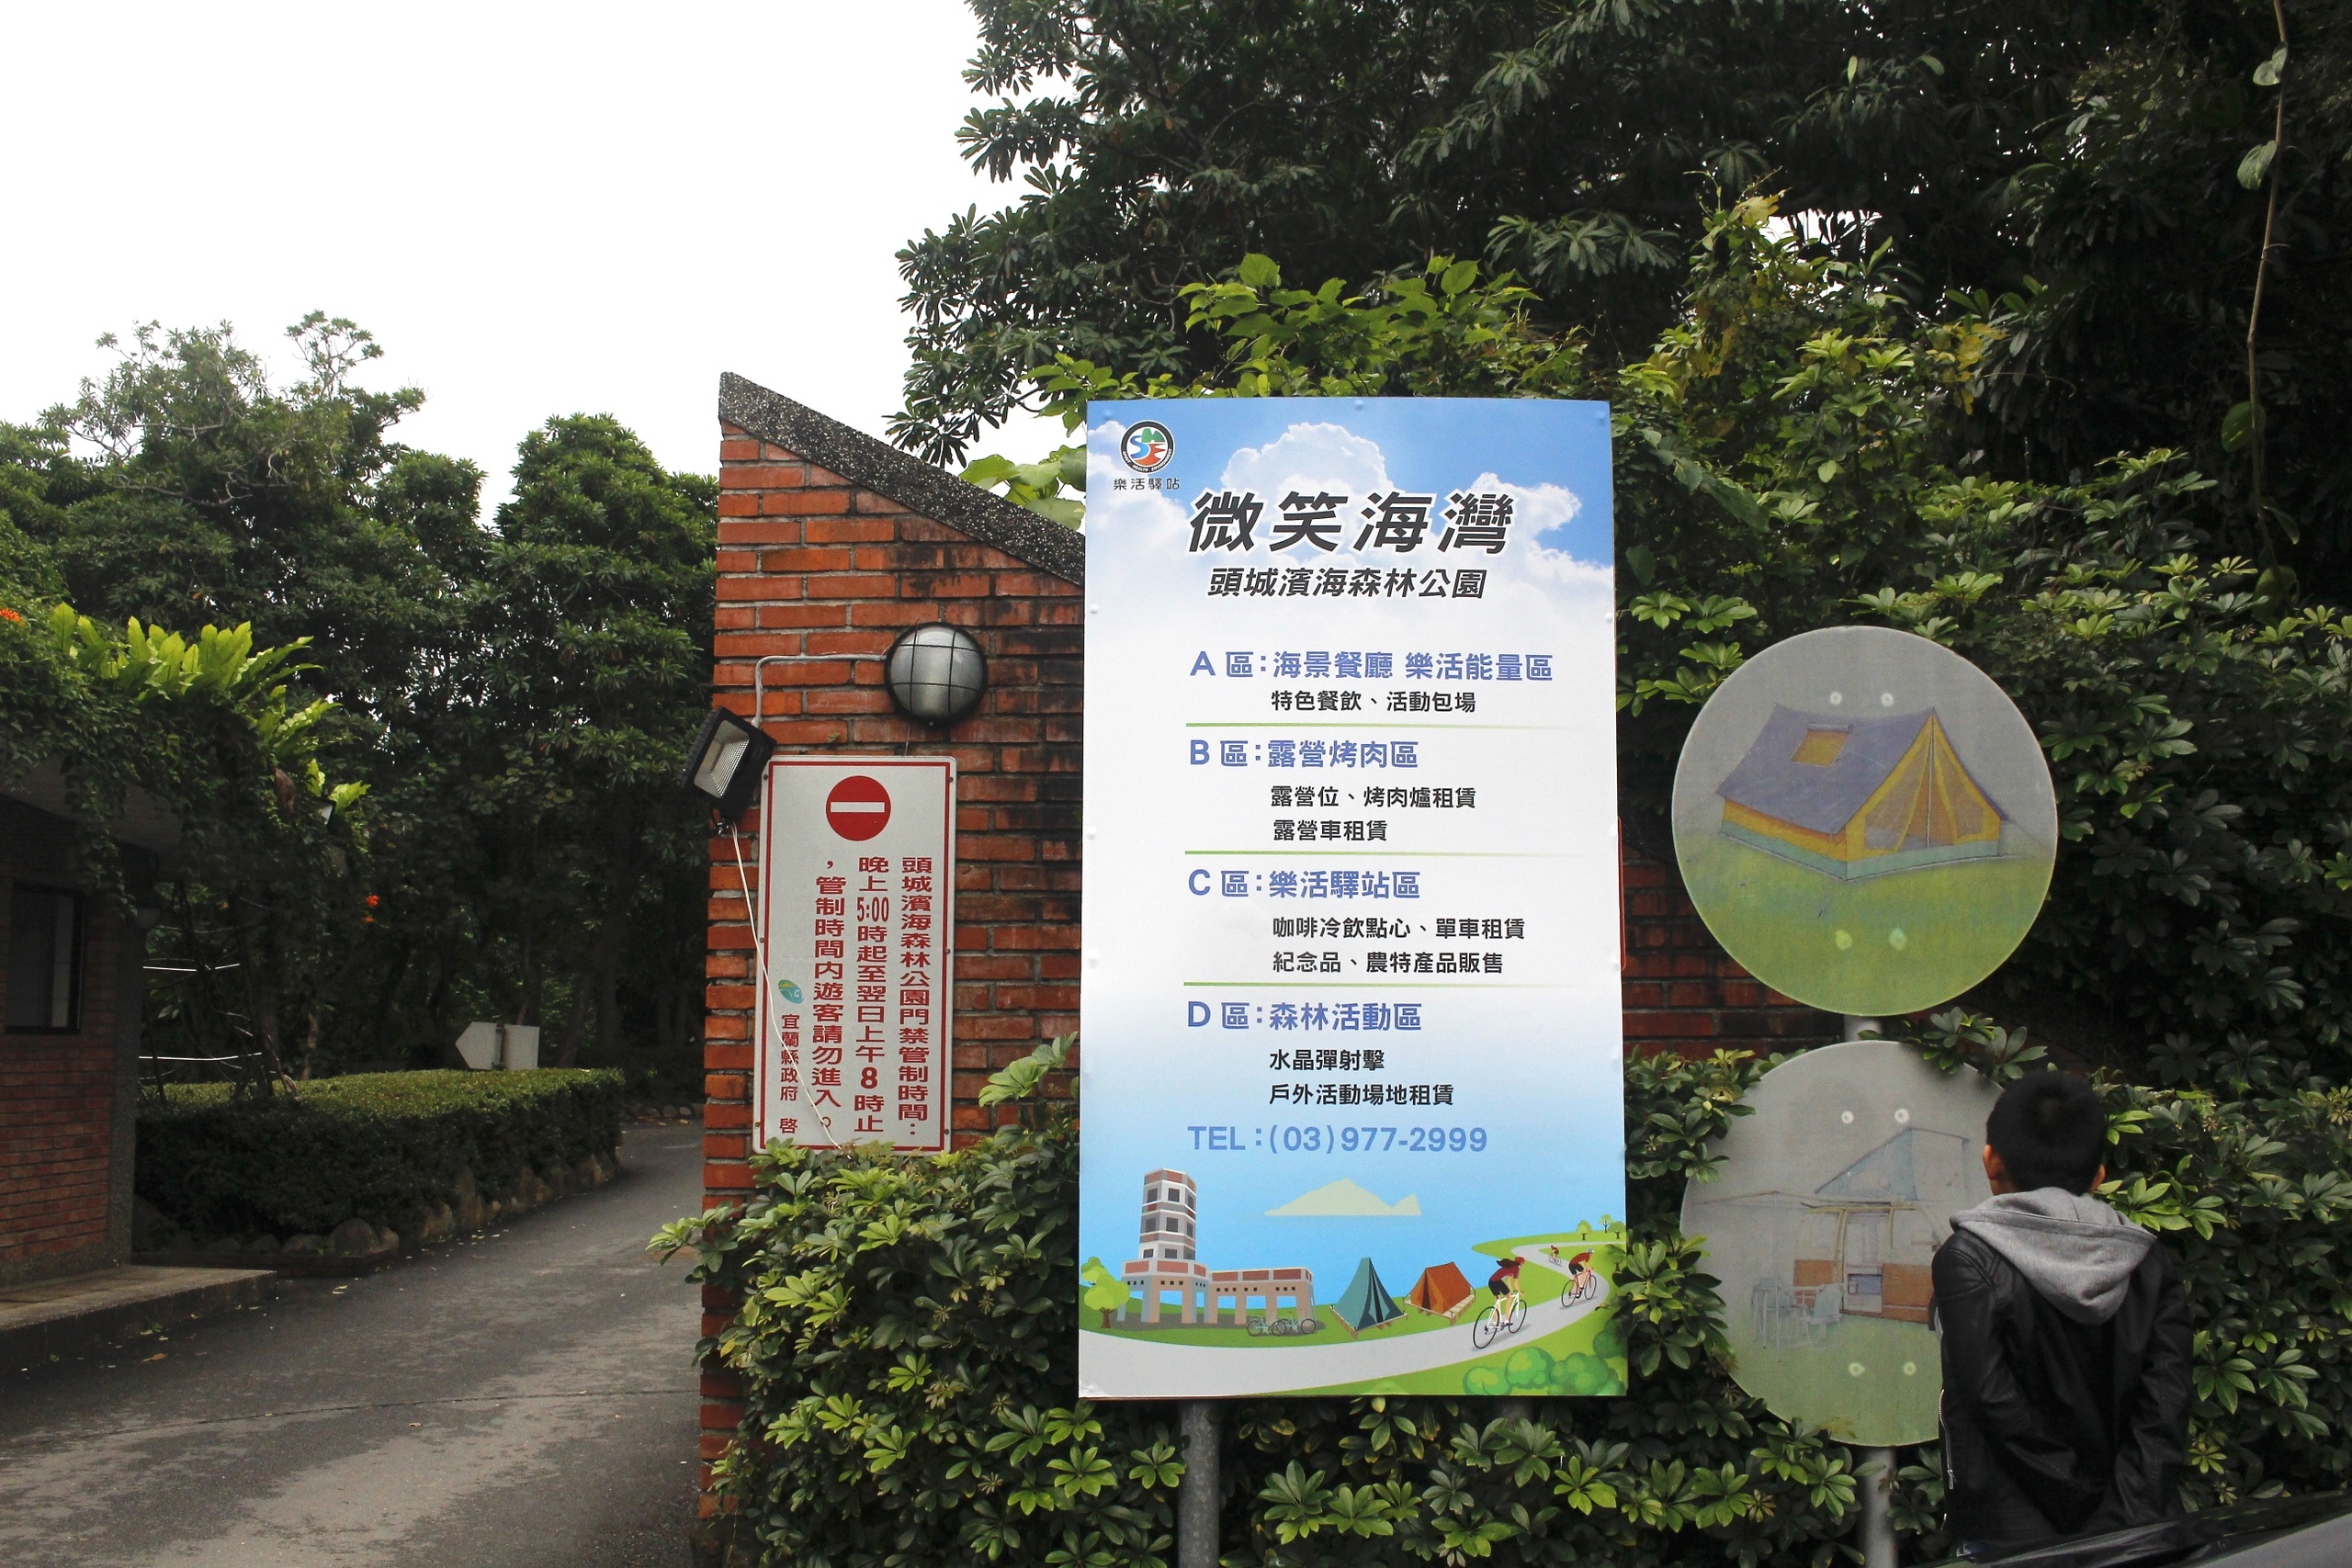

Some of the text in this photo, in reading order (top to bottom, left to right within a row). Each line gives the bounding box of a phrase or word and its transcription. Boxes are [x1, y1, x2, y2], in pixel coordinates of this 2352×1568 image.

[1114, 478, 1181, 491] 樂活驛站
[1189, 491, 1514, 555] 微笑海灣
[1207, 567, 1487, 599] 頭城濱海森林公園
[1271, 690, 1476, 713] 特色餐飲、活動包場
[1271, 785, 1476, 808] 露營位、烤肉爐租賃
[1273, 819, 1387, 841] 露營車租賃
[1272, 916, 1525, 940] 咖啡冷飲點心、單車租賃
[1272, 951, 1503, 974] 紀念品、農特產品販售
[854, 856, 889, 1133] 晚上5:00時起至翌日上午8時止
[898, 856, 933, 1135] 頭城濱海森林公園門禁管制時間：
[780, 1014, 799, 1101] 宜蘭縣政府
[1269, 1048, 1385, 1071] 水晶彈射擊
[1269, 1083, 1454, 1106] 戶外活動場地租賃
